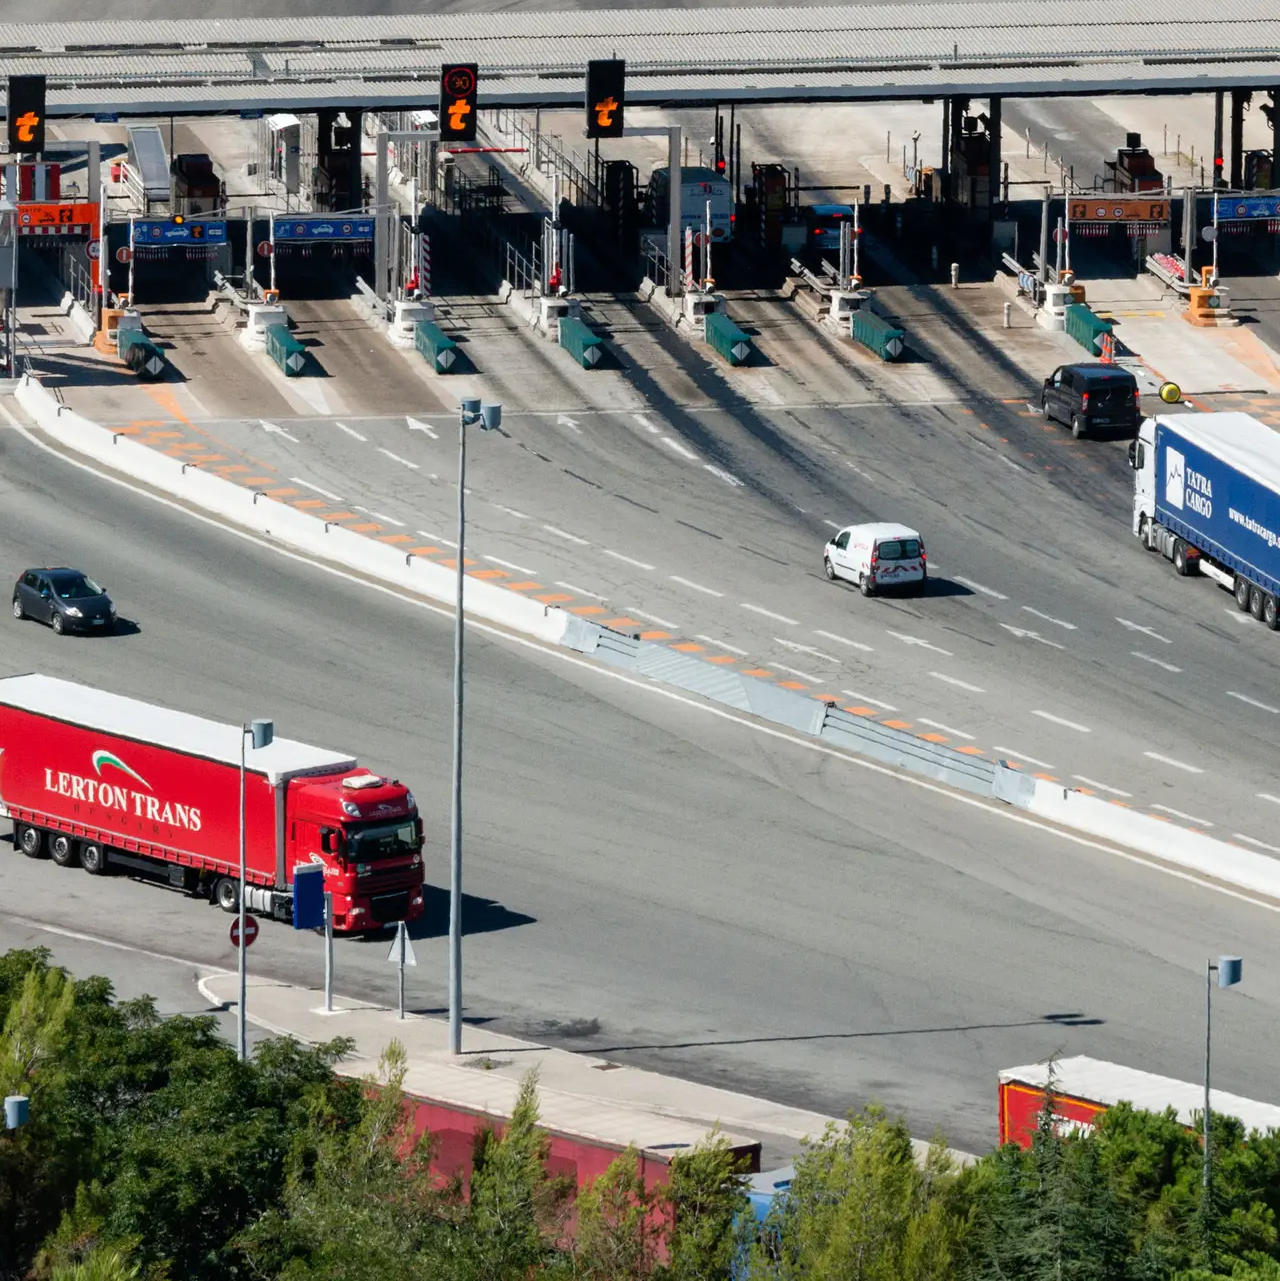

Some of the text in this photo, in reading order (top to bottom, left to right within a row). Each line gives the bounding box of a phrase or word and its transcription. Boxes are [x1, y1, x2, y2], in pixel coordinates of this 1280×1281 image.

[1186, 467, 1213, 498] TATRA
[1185, 490, 1213, 519] CARGO
[44, 768, 202, 832] LERTON TRANS
